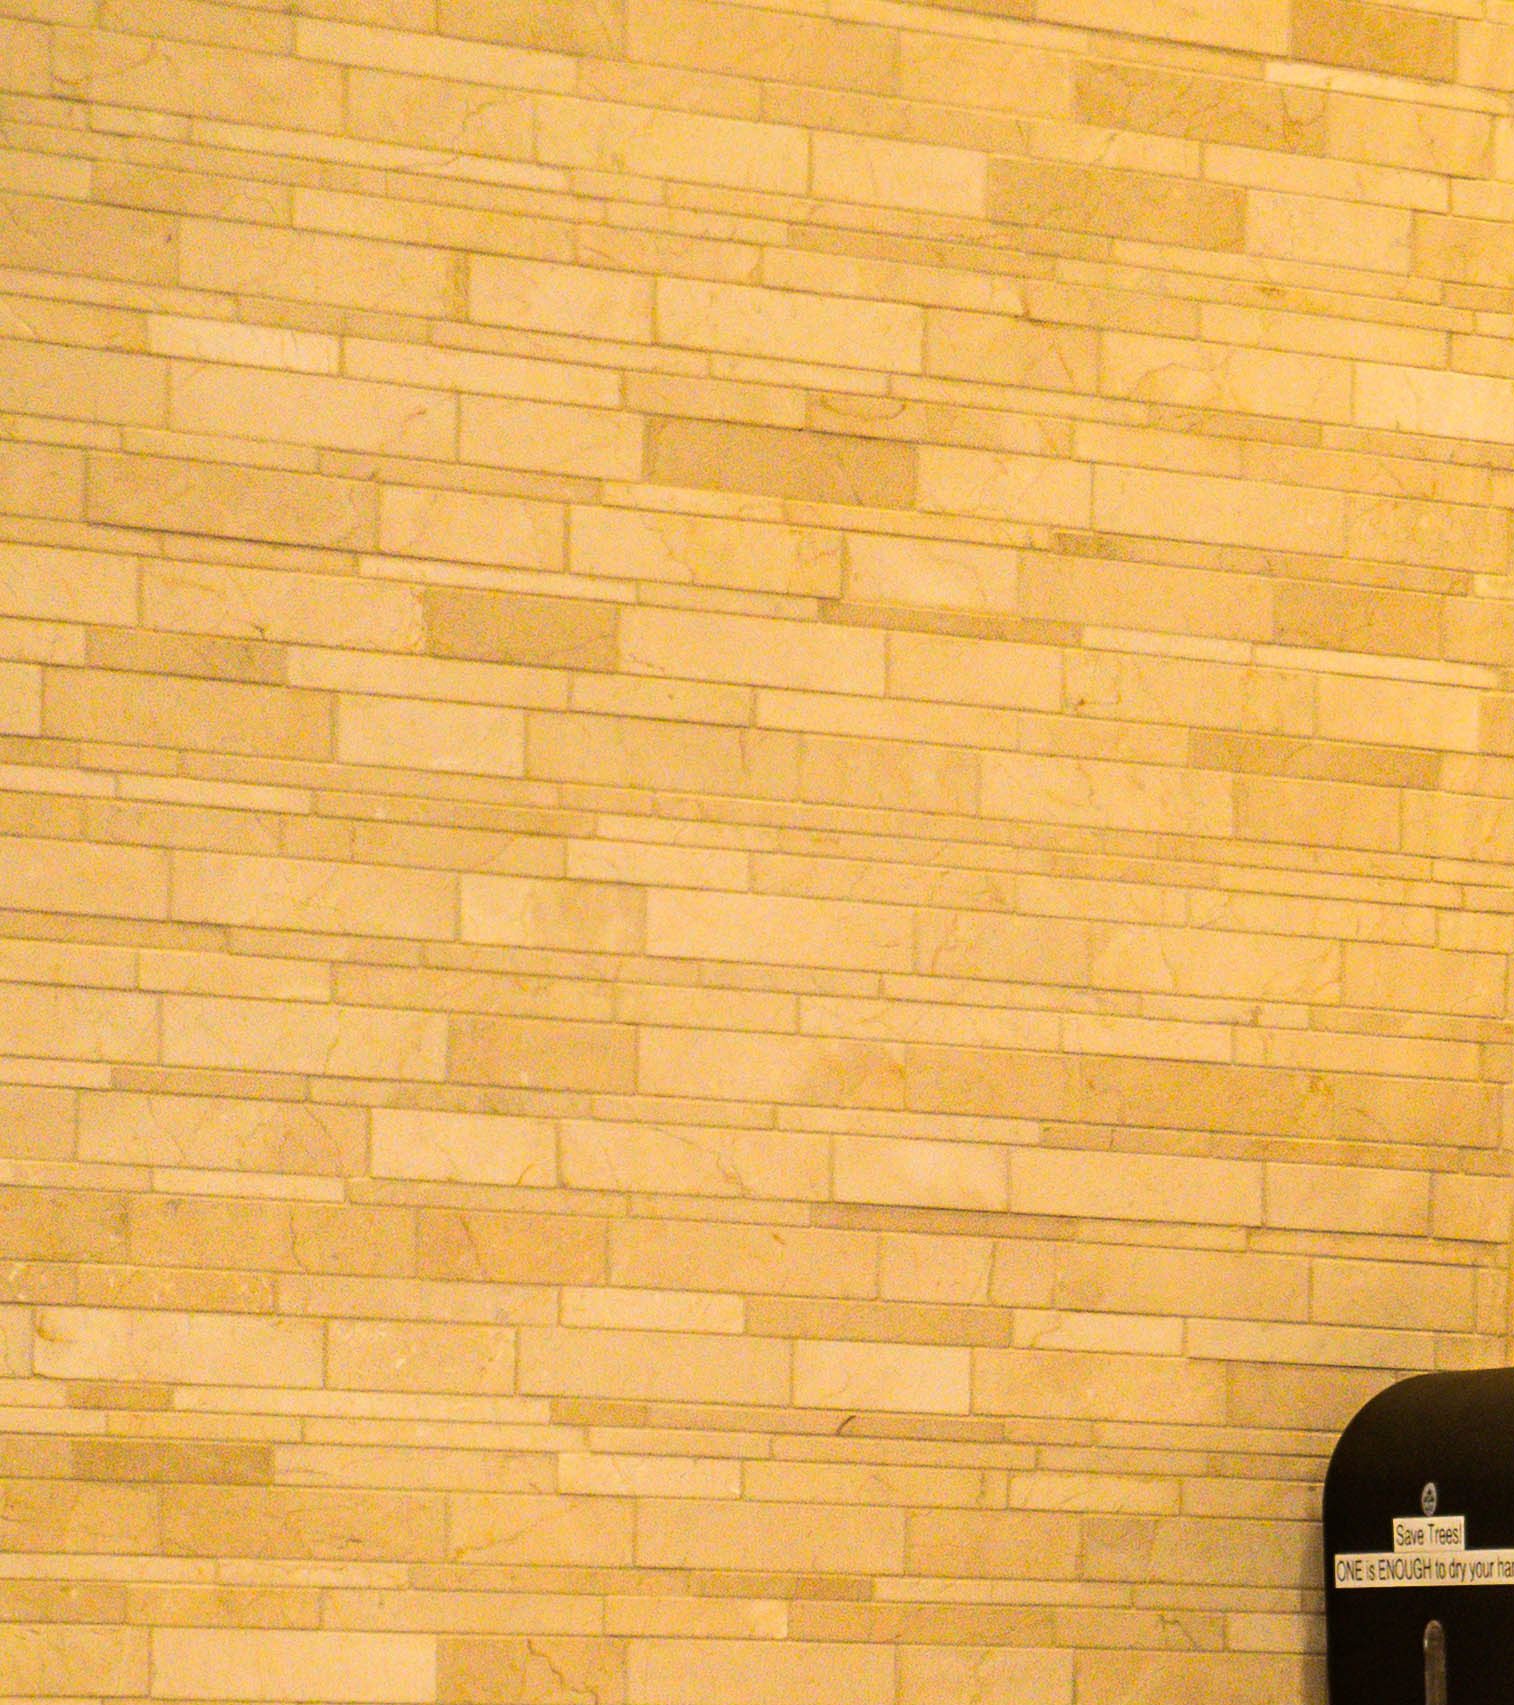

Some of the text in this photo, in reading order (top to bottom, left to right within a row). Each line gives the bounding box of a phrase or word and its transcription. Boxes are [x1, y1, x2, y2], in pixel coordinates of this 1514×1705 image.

[1396, 1523, 1462, 1546] Save Trees!
[1336, 1560, 1363, 1582] ONE
[1366, 1559, 1375, 1581] is
[1378, 1557, 1432, 1581] ENOUGH
[1435, 1559, 1447, 1580] to
[1447, 1557, 1468, 1582] dry
[1468, 1560, 1494, 1582] your
